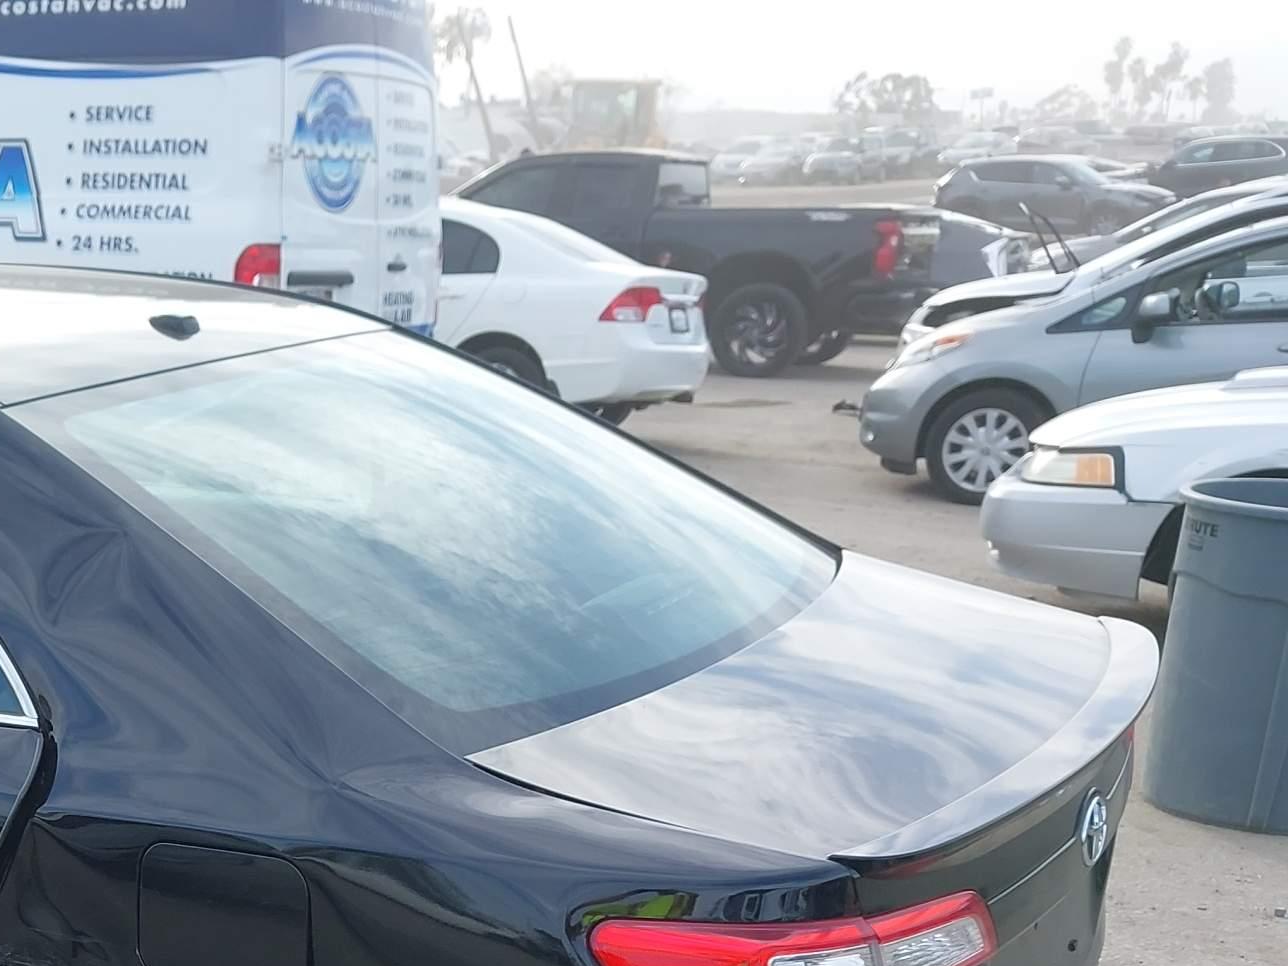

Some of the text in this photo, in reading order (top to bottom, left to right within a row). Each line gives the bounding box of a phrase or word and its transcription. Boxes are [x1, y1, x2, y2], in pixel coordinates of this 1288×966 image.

[85, 105, 154, 122] SERVICE
[82, 138, 208, 156] INSTALLATION
[80, 171, 189, 191] RESIDENTIAL
[75, 202, 192, 221] COMMERCIAL
[72, 234, 139, 253] 24 HRS.
